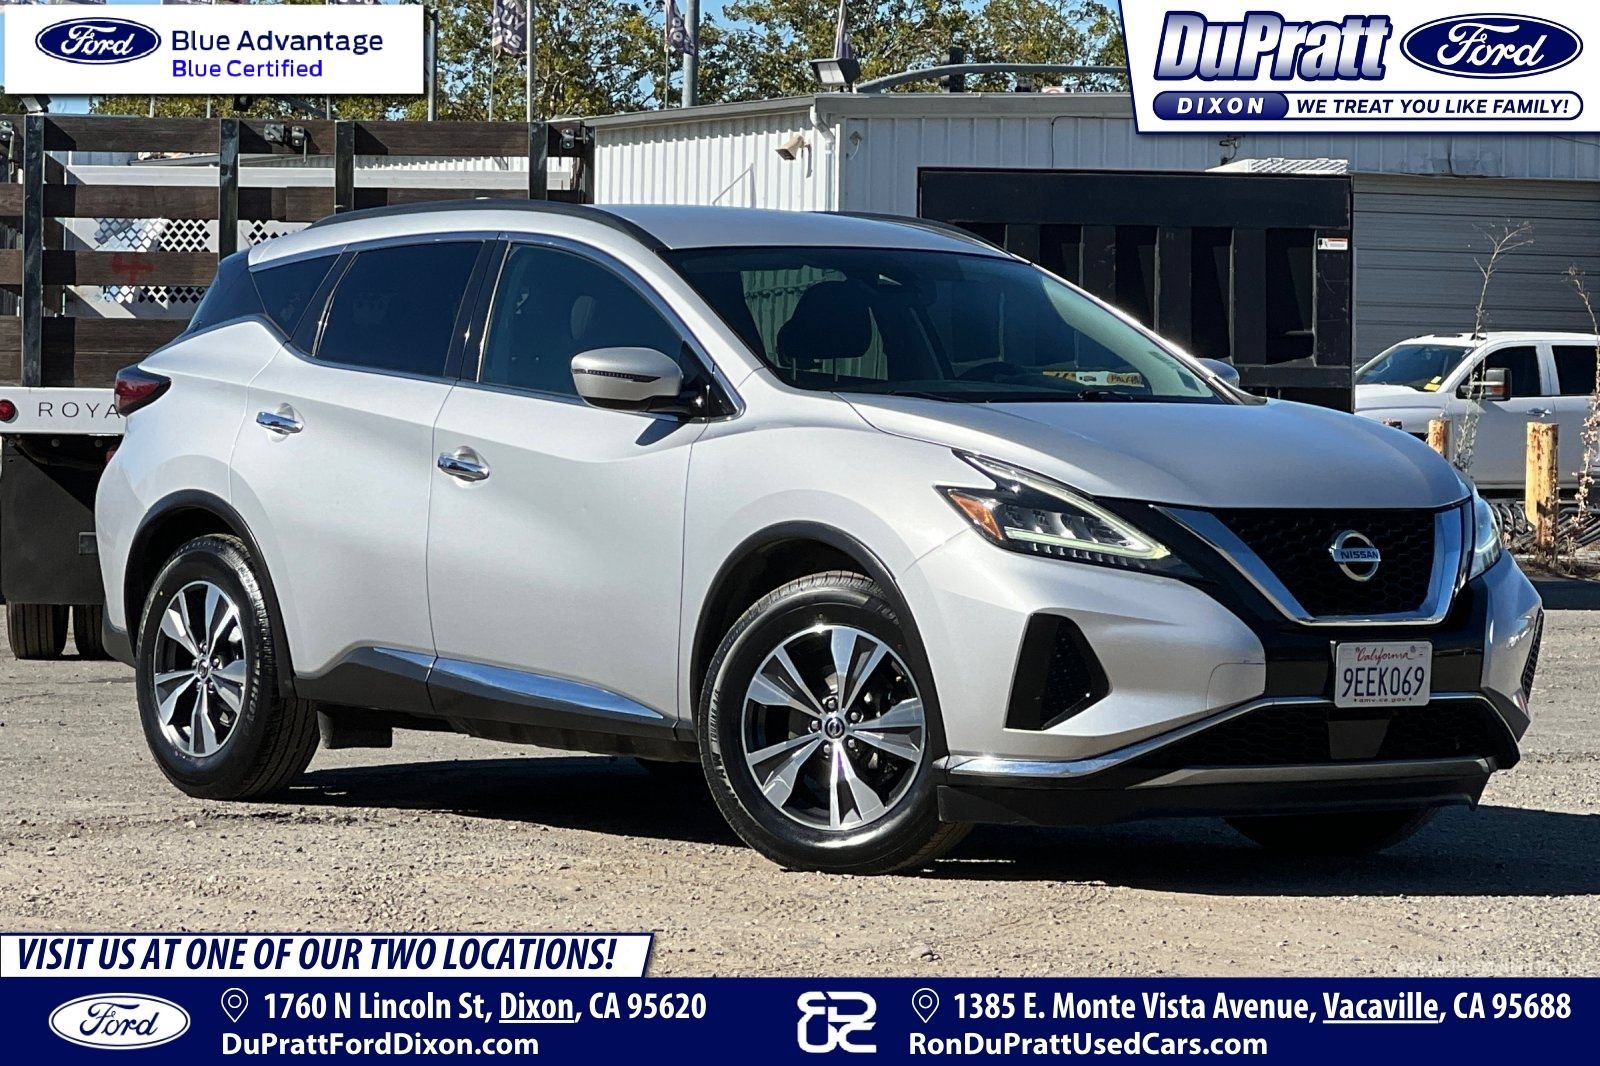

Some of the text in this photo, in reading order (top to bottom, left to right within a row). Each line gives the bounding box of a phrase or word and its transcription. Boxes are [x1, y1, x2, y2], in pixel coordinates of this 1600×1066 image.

[1340, 550, 1379, 560] NISSAN
[1356, 647, 1412, 665] California
[1342, 666, 1425, 698] 9EEK069
